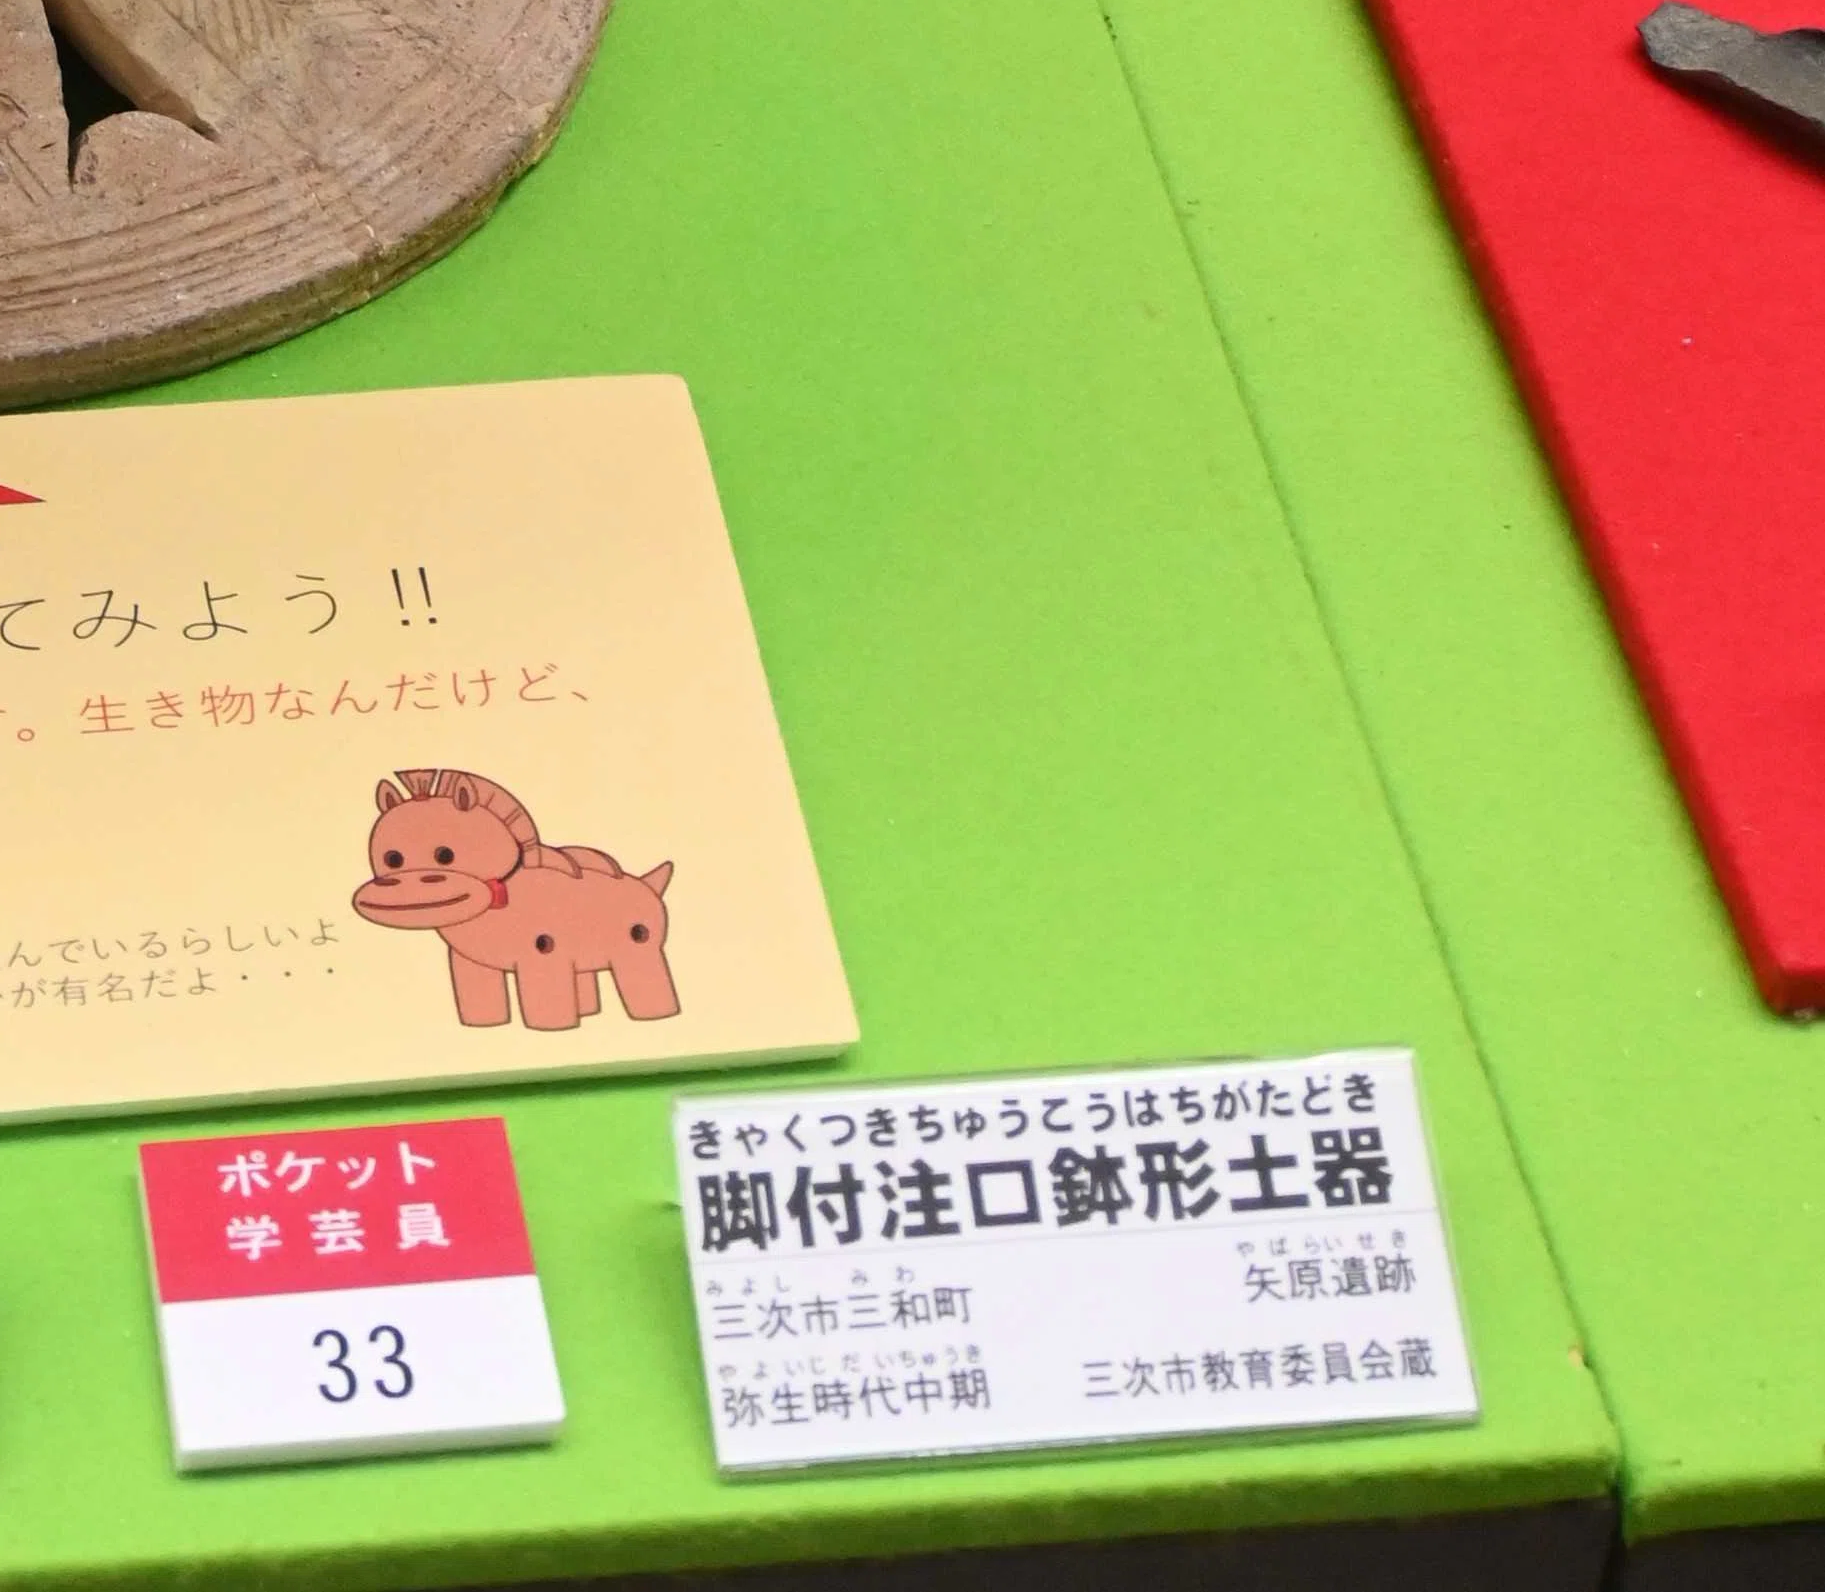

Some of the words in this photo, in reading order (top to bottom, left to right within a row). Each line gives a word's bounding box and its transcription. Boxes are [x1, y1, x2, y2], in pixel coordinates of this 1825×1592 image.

[688, 1071, 1377, 1161] きゃくつきちゅうこうはちがたどき
[217, 1140, 436, 1198] ポケット
[697, 1126, 1394, 1253] 脚付注口鉢形土器
[225, 1202, 451, 1261] 学芸員
[1243, 1253, 1416, 1303] 矢原遺跡
[713, 1287, 973, 1340] 三次市三和町
[312, 1324, 415, 1403] 33
[1083, 1337, 1438, 1399] 三次市教育委員会蔵
[725, 1367, 992, 1429] 弥生時代中期
